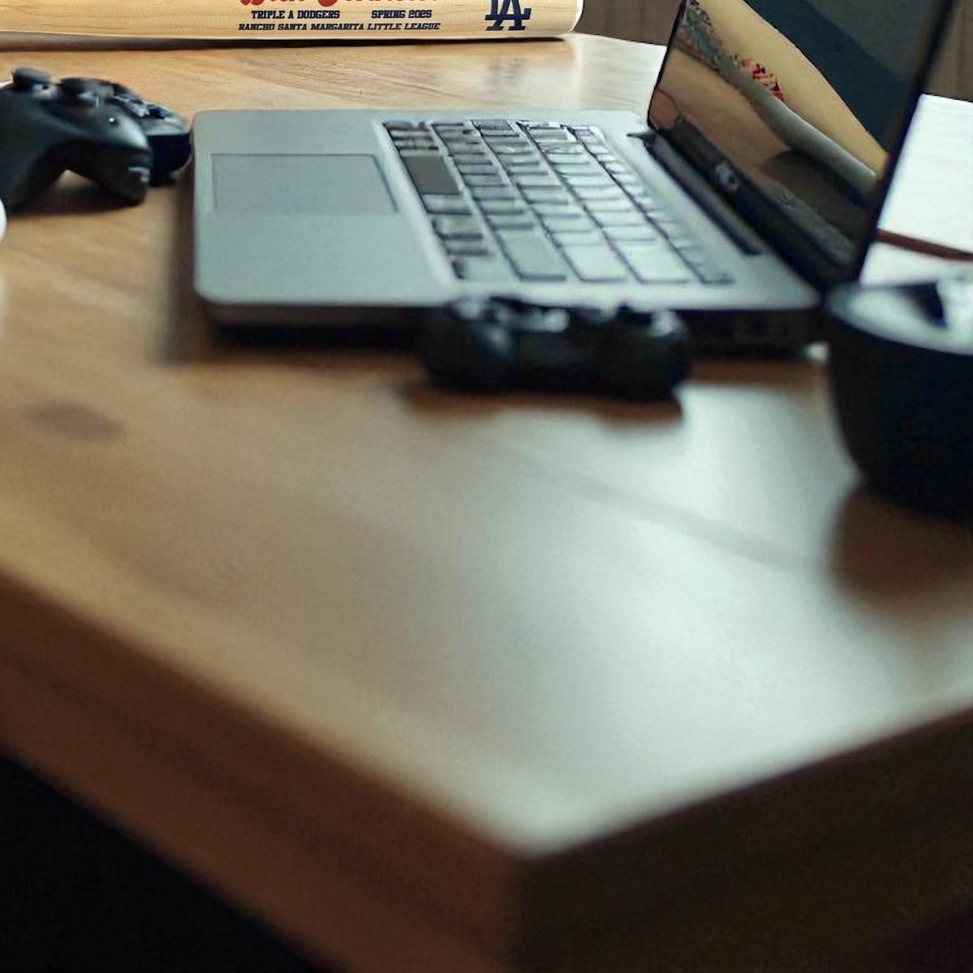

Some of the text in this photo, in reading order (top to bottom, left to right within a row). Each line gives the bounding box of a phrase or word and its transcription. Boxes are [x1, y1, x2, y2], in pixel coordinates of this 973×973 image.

[251, 10, 341, 19] TRIPLE A DODGERS
[371, 9, 433, 19] SPRING 2025
[238, 22, 442, 31] RANCHO SANTA MARGARITA LITTLE LEAGUE
